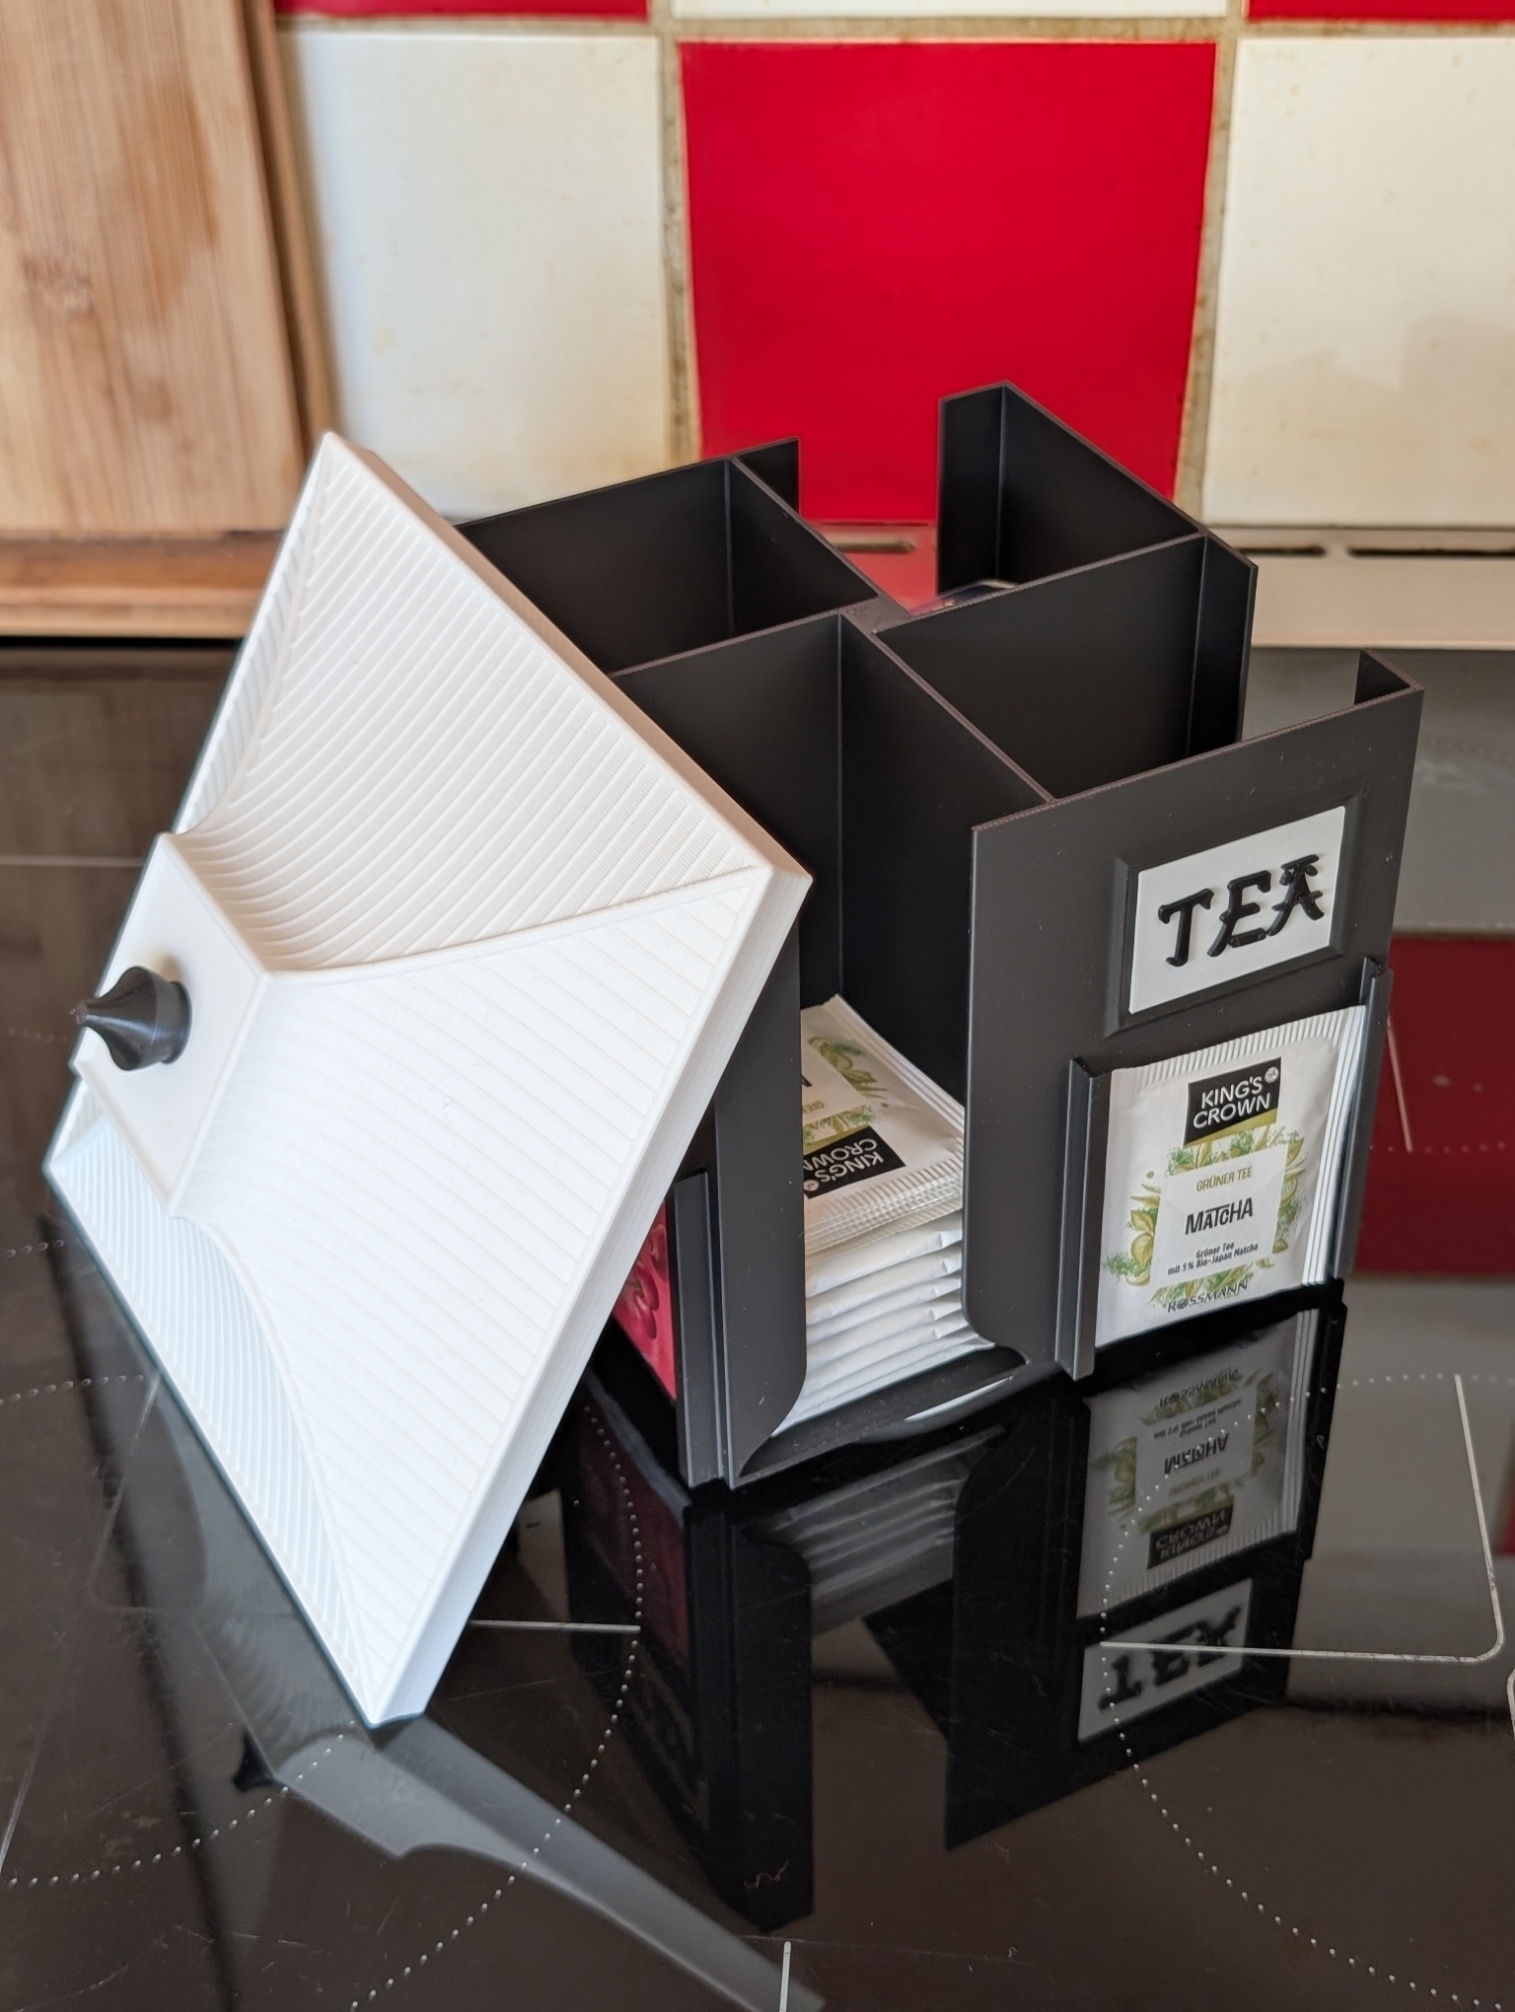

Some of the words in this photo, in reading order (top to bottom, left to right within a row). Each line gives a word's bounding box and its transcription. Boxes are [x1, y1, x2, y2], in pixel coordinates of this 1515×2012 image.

[1158, 854, 1325, 967] TEA
[1201, 1076, 1263, 1109] KING'S
[1193, 1092, 1271, 1129] CROWN
[814, 1151, 884, 1183] KING'S
[1196, 1171, 1235, 1192] GRÜNER
[1236, 1166, 1253, 1181] TEE
[1185, 1197, 1254, 1236] MATCHA
[1167, 1264, 1181, 1276] mit
[1233, 1242, 1259, 1258] Matcha
[1195, 1245, 1221, 1260] Grüner
[1222, 1241, 1235, 1252] Tee
[1167, 1277, 1248, 1313] ROSSMANN
